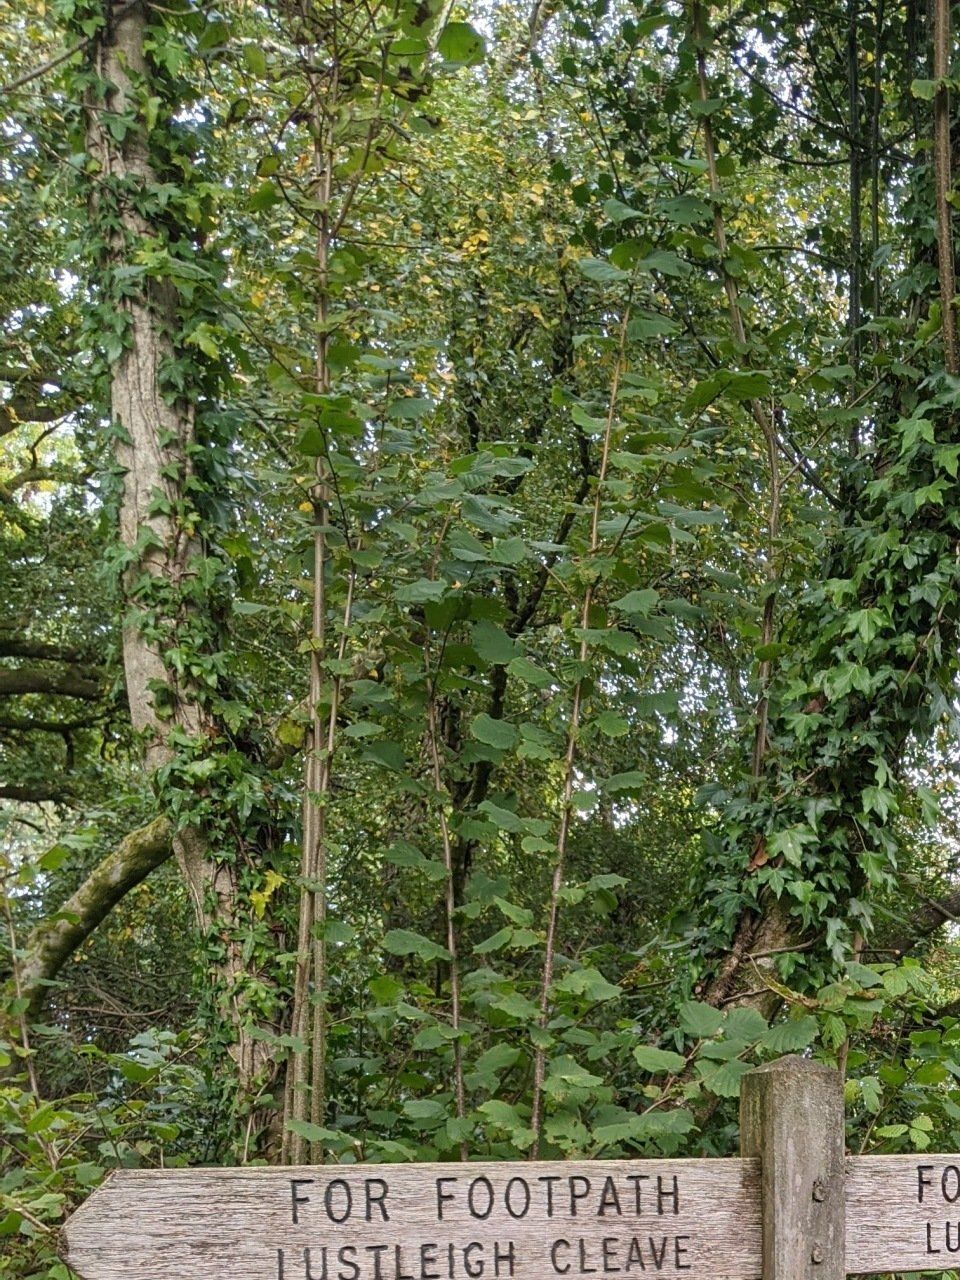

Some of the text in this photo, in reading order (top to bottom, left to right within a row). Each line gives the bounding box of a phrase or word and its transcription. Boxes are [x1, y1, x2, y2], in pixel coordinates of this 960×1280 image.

[290, 1175, 680, 1224] FOR FOOTPATH
[550, 1235, 692, 1275] CLEAVE
